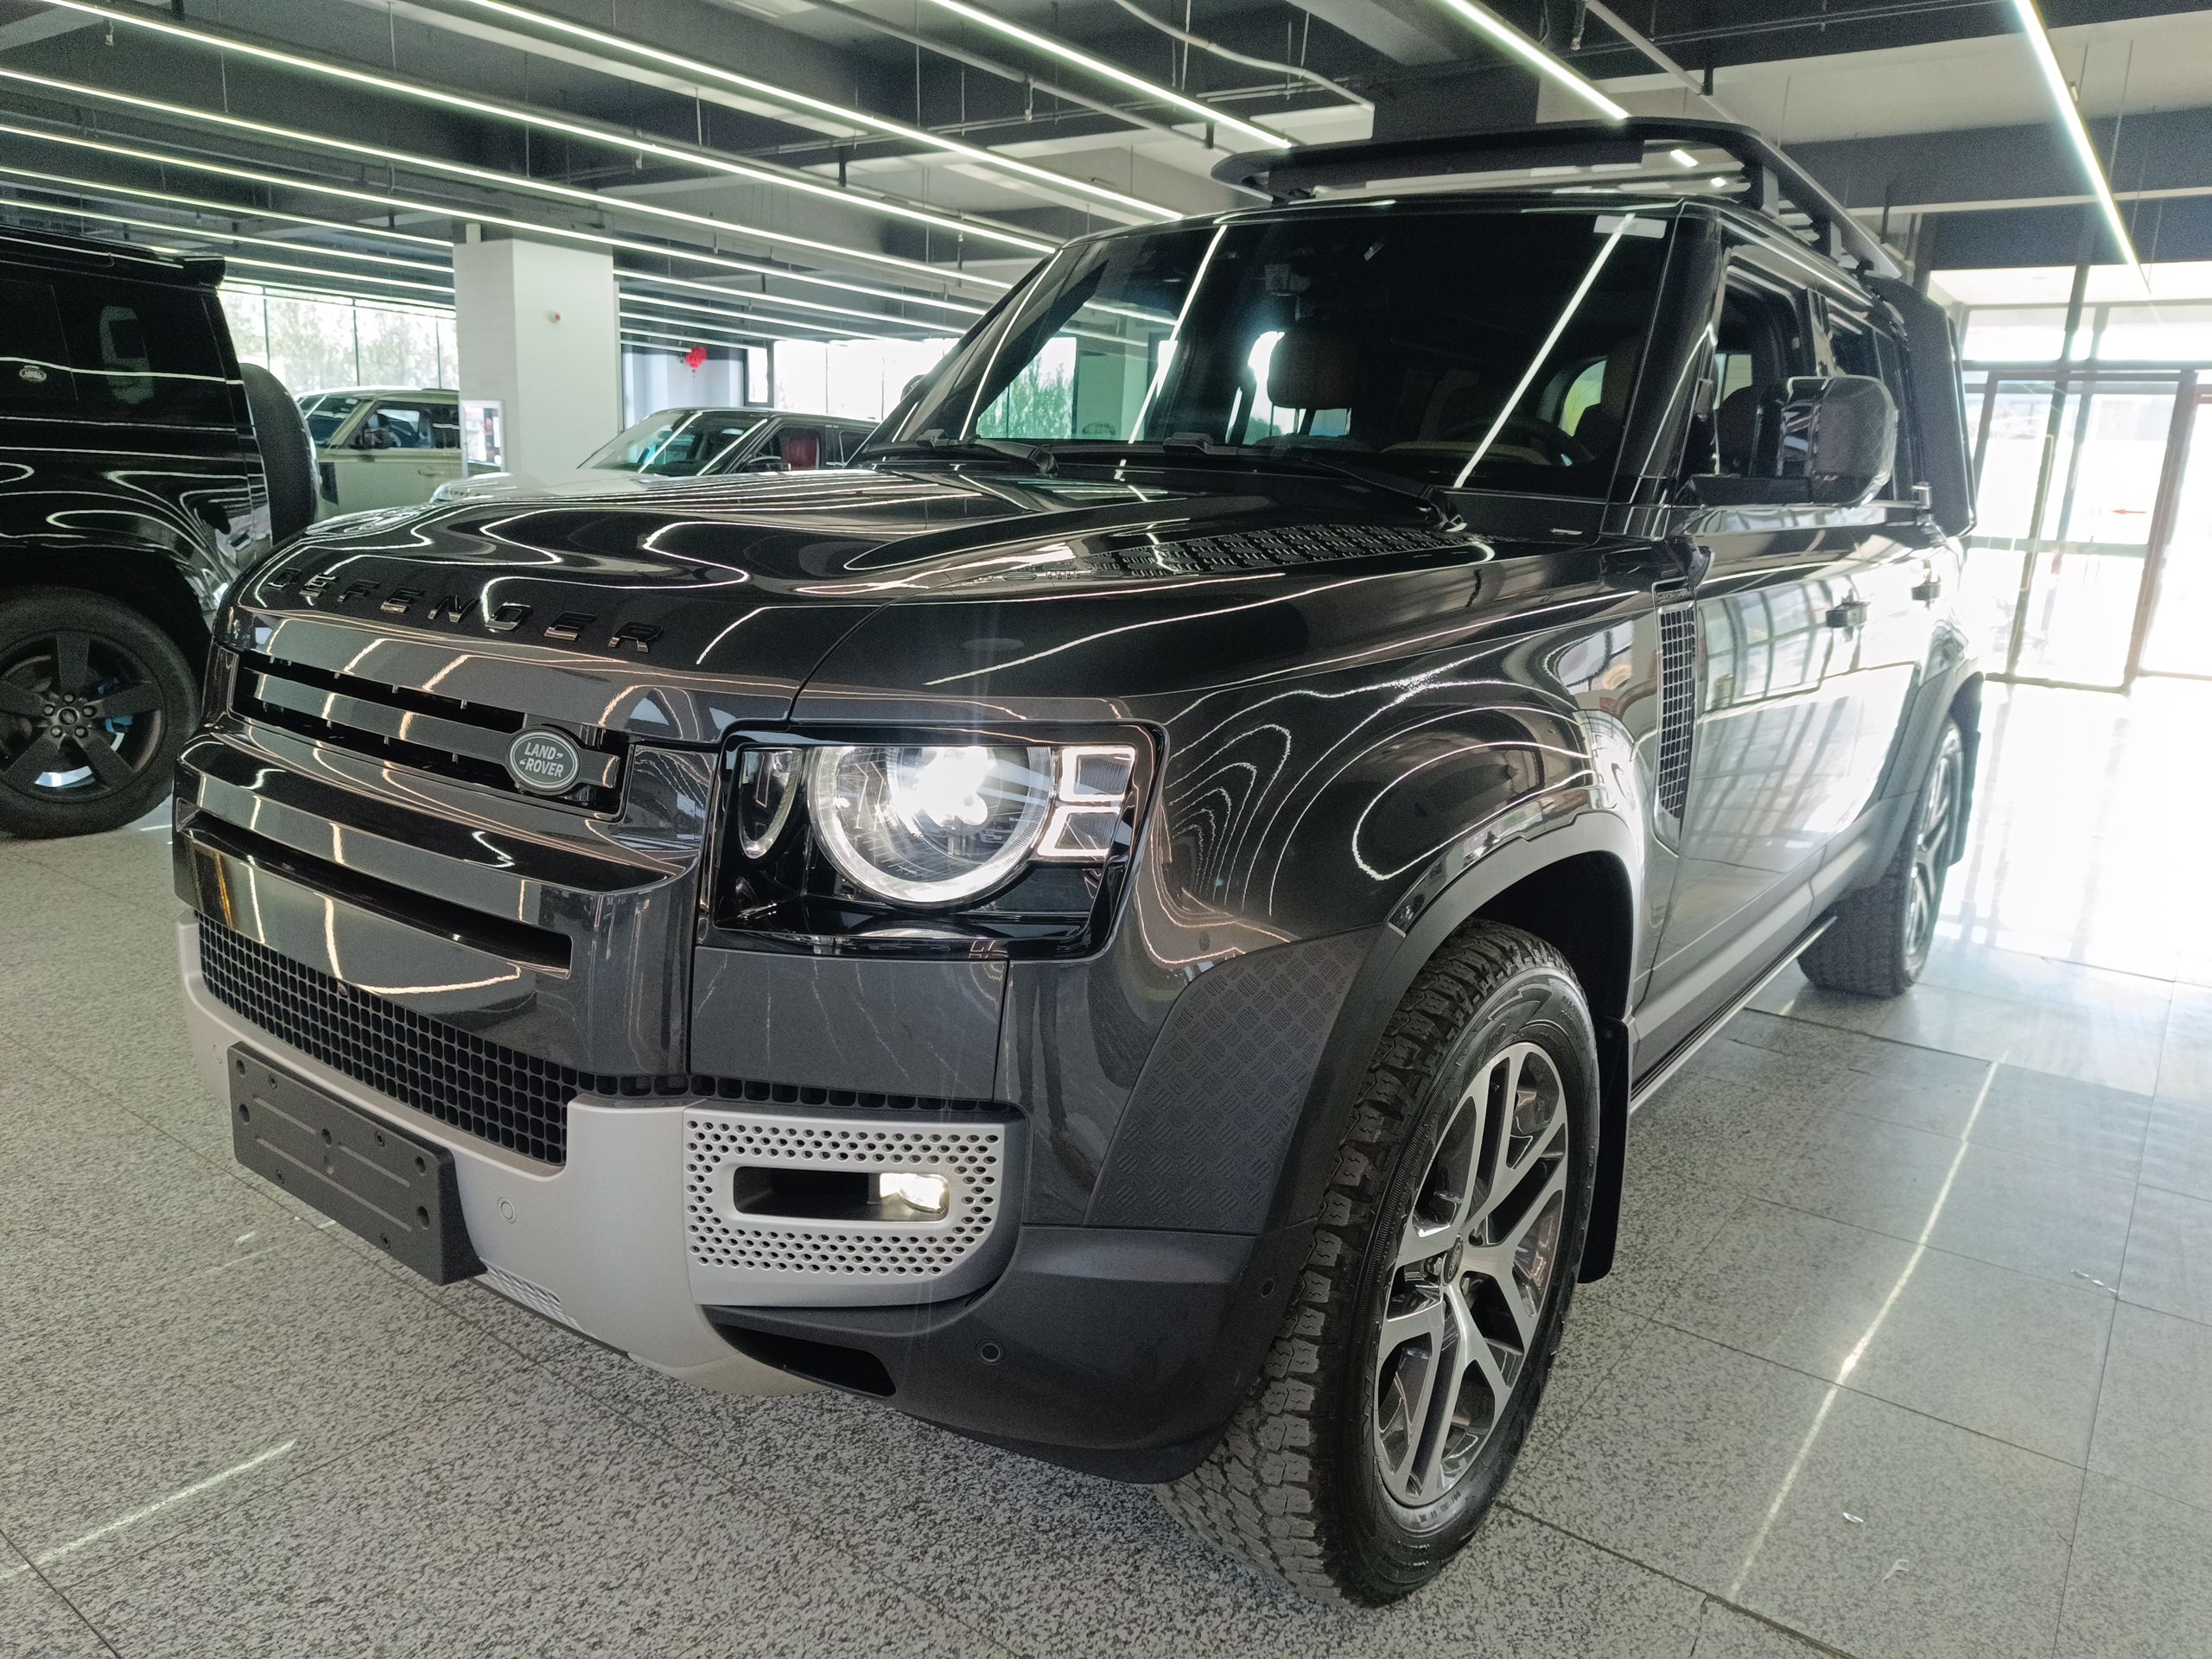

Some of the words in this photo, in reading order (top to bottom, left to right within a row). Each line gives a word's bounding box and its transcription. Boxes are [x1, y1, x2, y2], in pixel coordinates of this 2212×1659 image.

[267, 567, 663, 653] DEFENDER
[524, 742, 556, 760] LAND
[525, 758, 564, 777] ROVER
